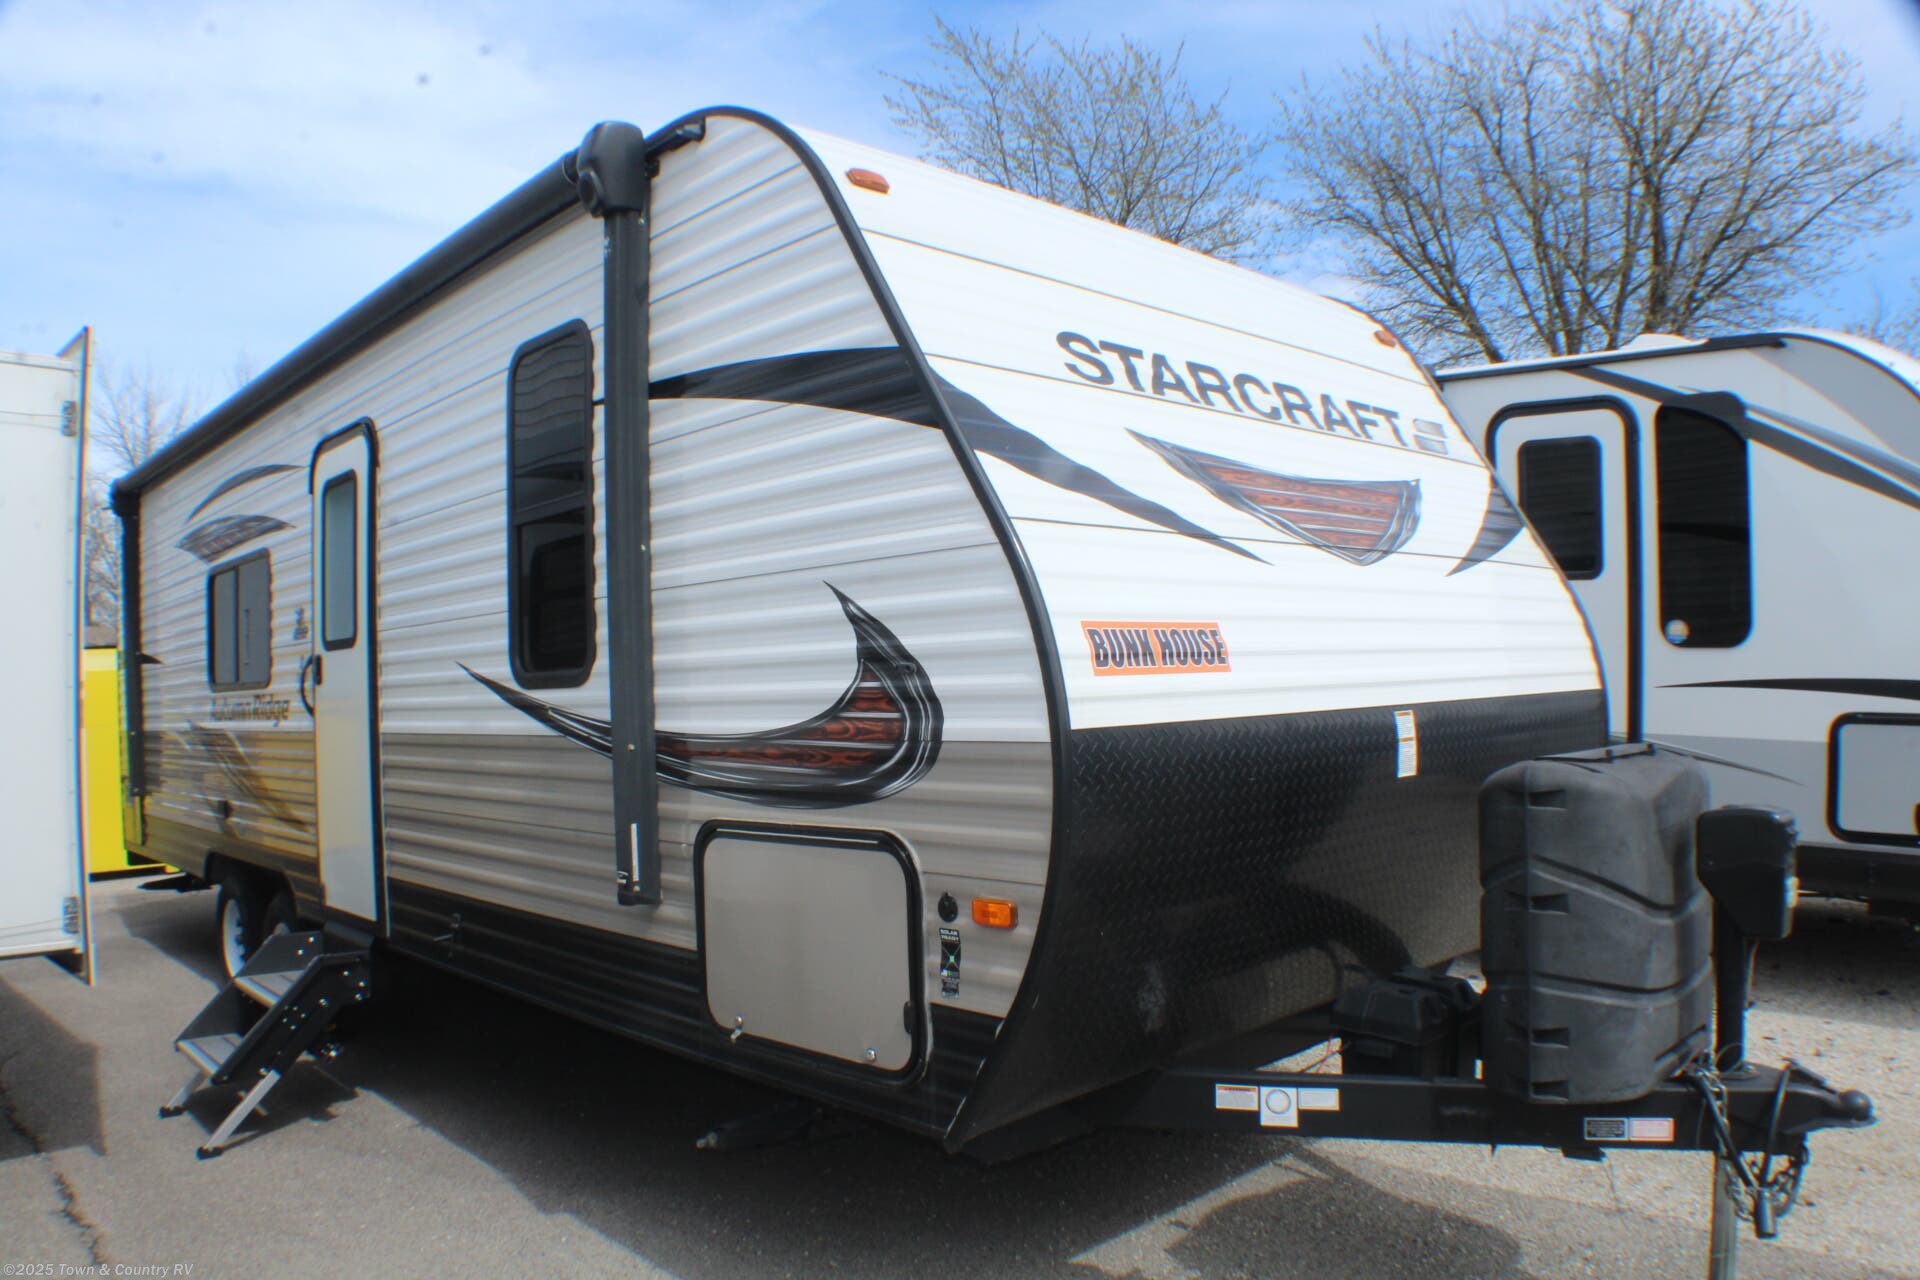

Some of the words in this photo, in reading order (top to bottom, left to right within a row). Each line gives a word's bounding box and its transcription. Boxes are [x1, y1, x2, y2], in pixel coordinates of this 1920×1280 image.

[1056, 331, 1408, 447] STARCRAFT
[1087, 628, 1157, 668] BUNK
[1153, 628, 1227, 666] HOUSE
